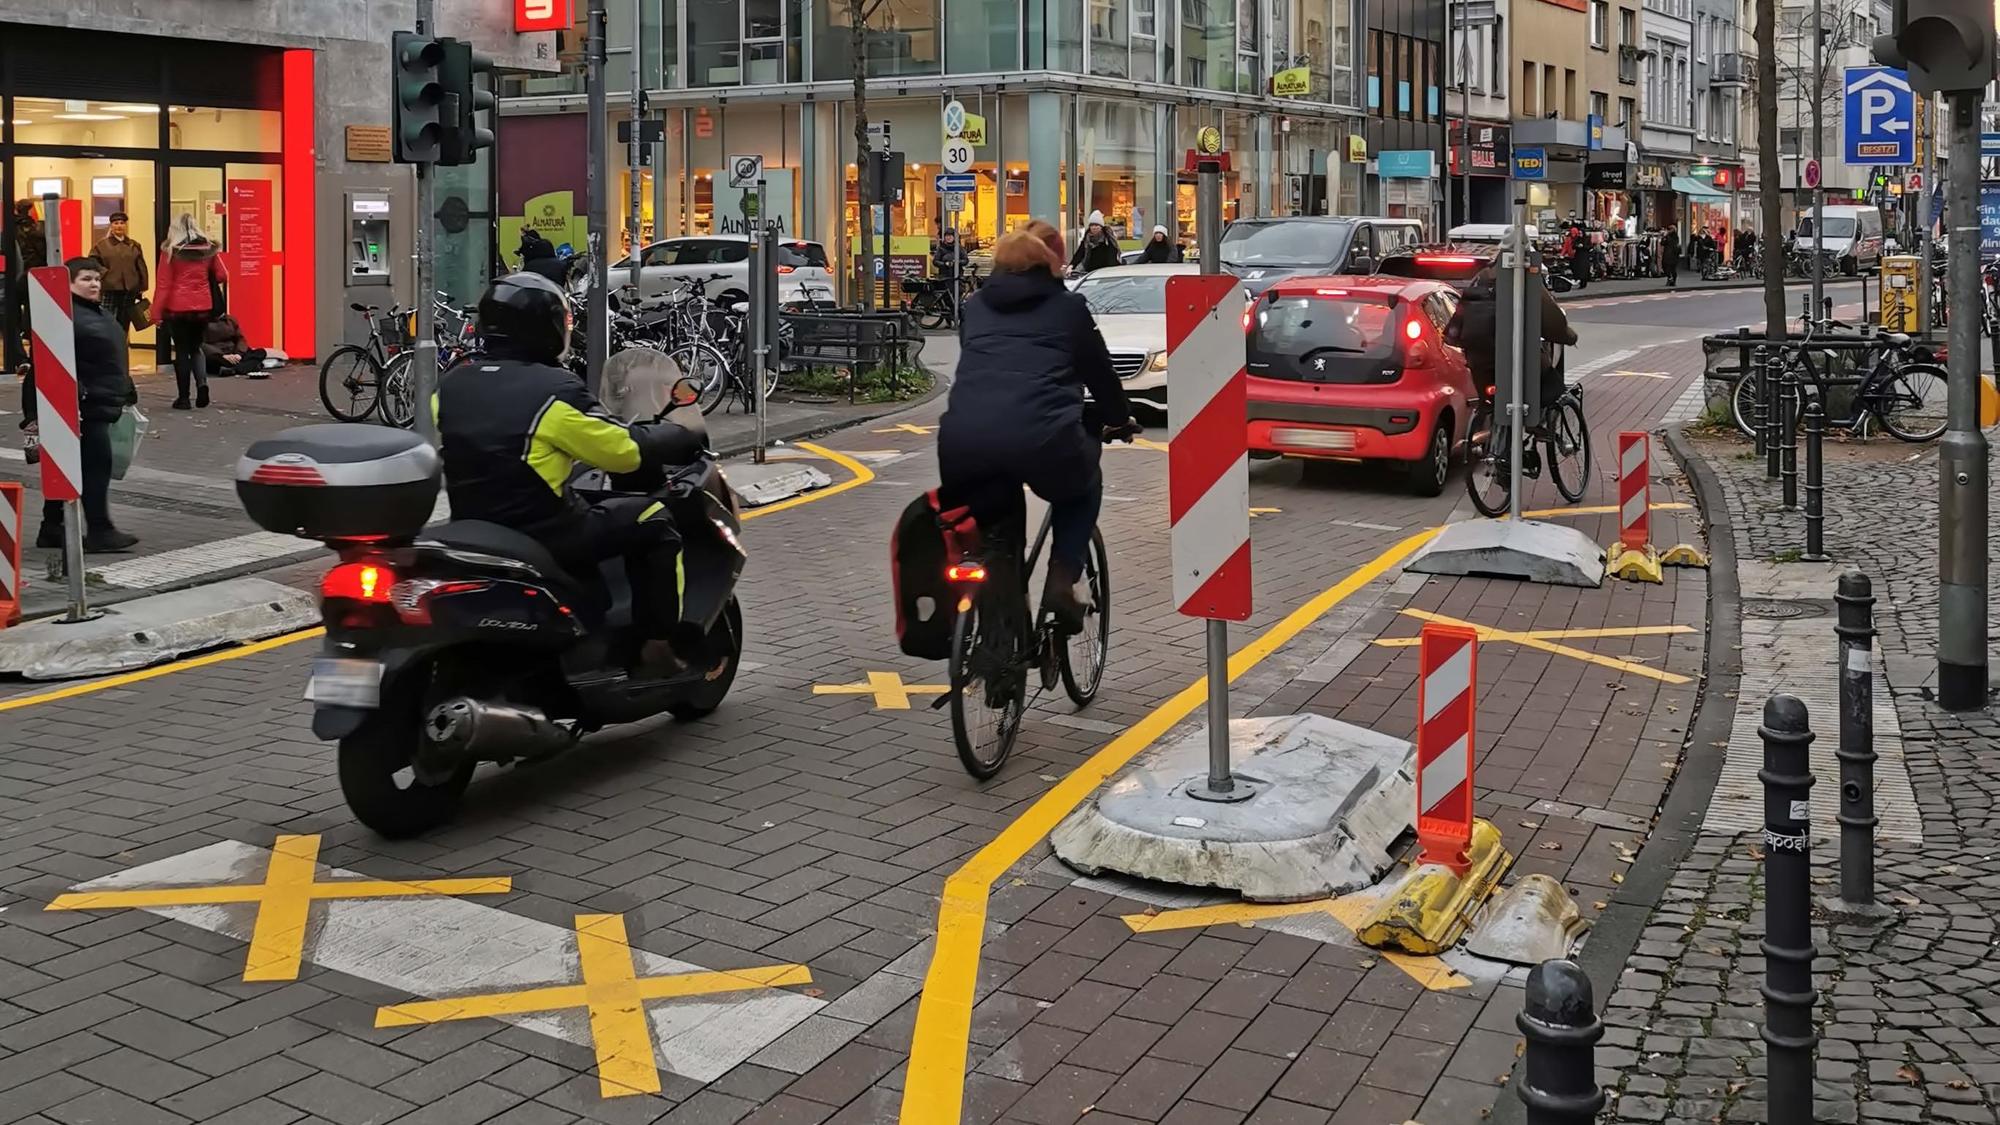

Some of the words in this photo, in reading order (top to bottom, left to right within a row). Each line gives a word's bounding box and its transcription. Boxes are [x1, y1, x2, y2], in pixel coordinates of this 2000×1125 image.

[1861, 89, 1896, 135] P
[949, 147, 967, 163] 30
[1861, 145, 1897, 154] BESETZT
[740, 163, 753, 174] 20
[1517, 158, 1542, 168] TEDi
[532, 216, 566, 227] ALNATURA
[875, 262, 884, 275] P
